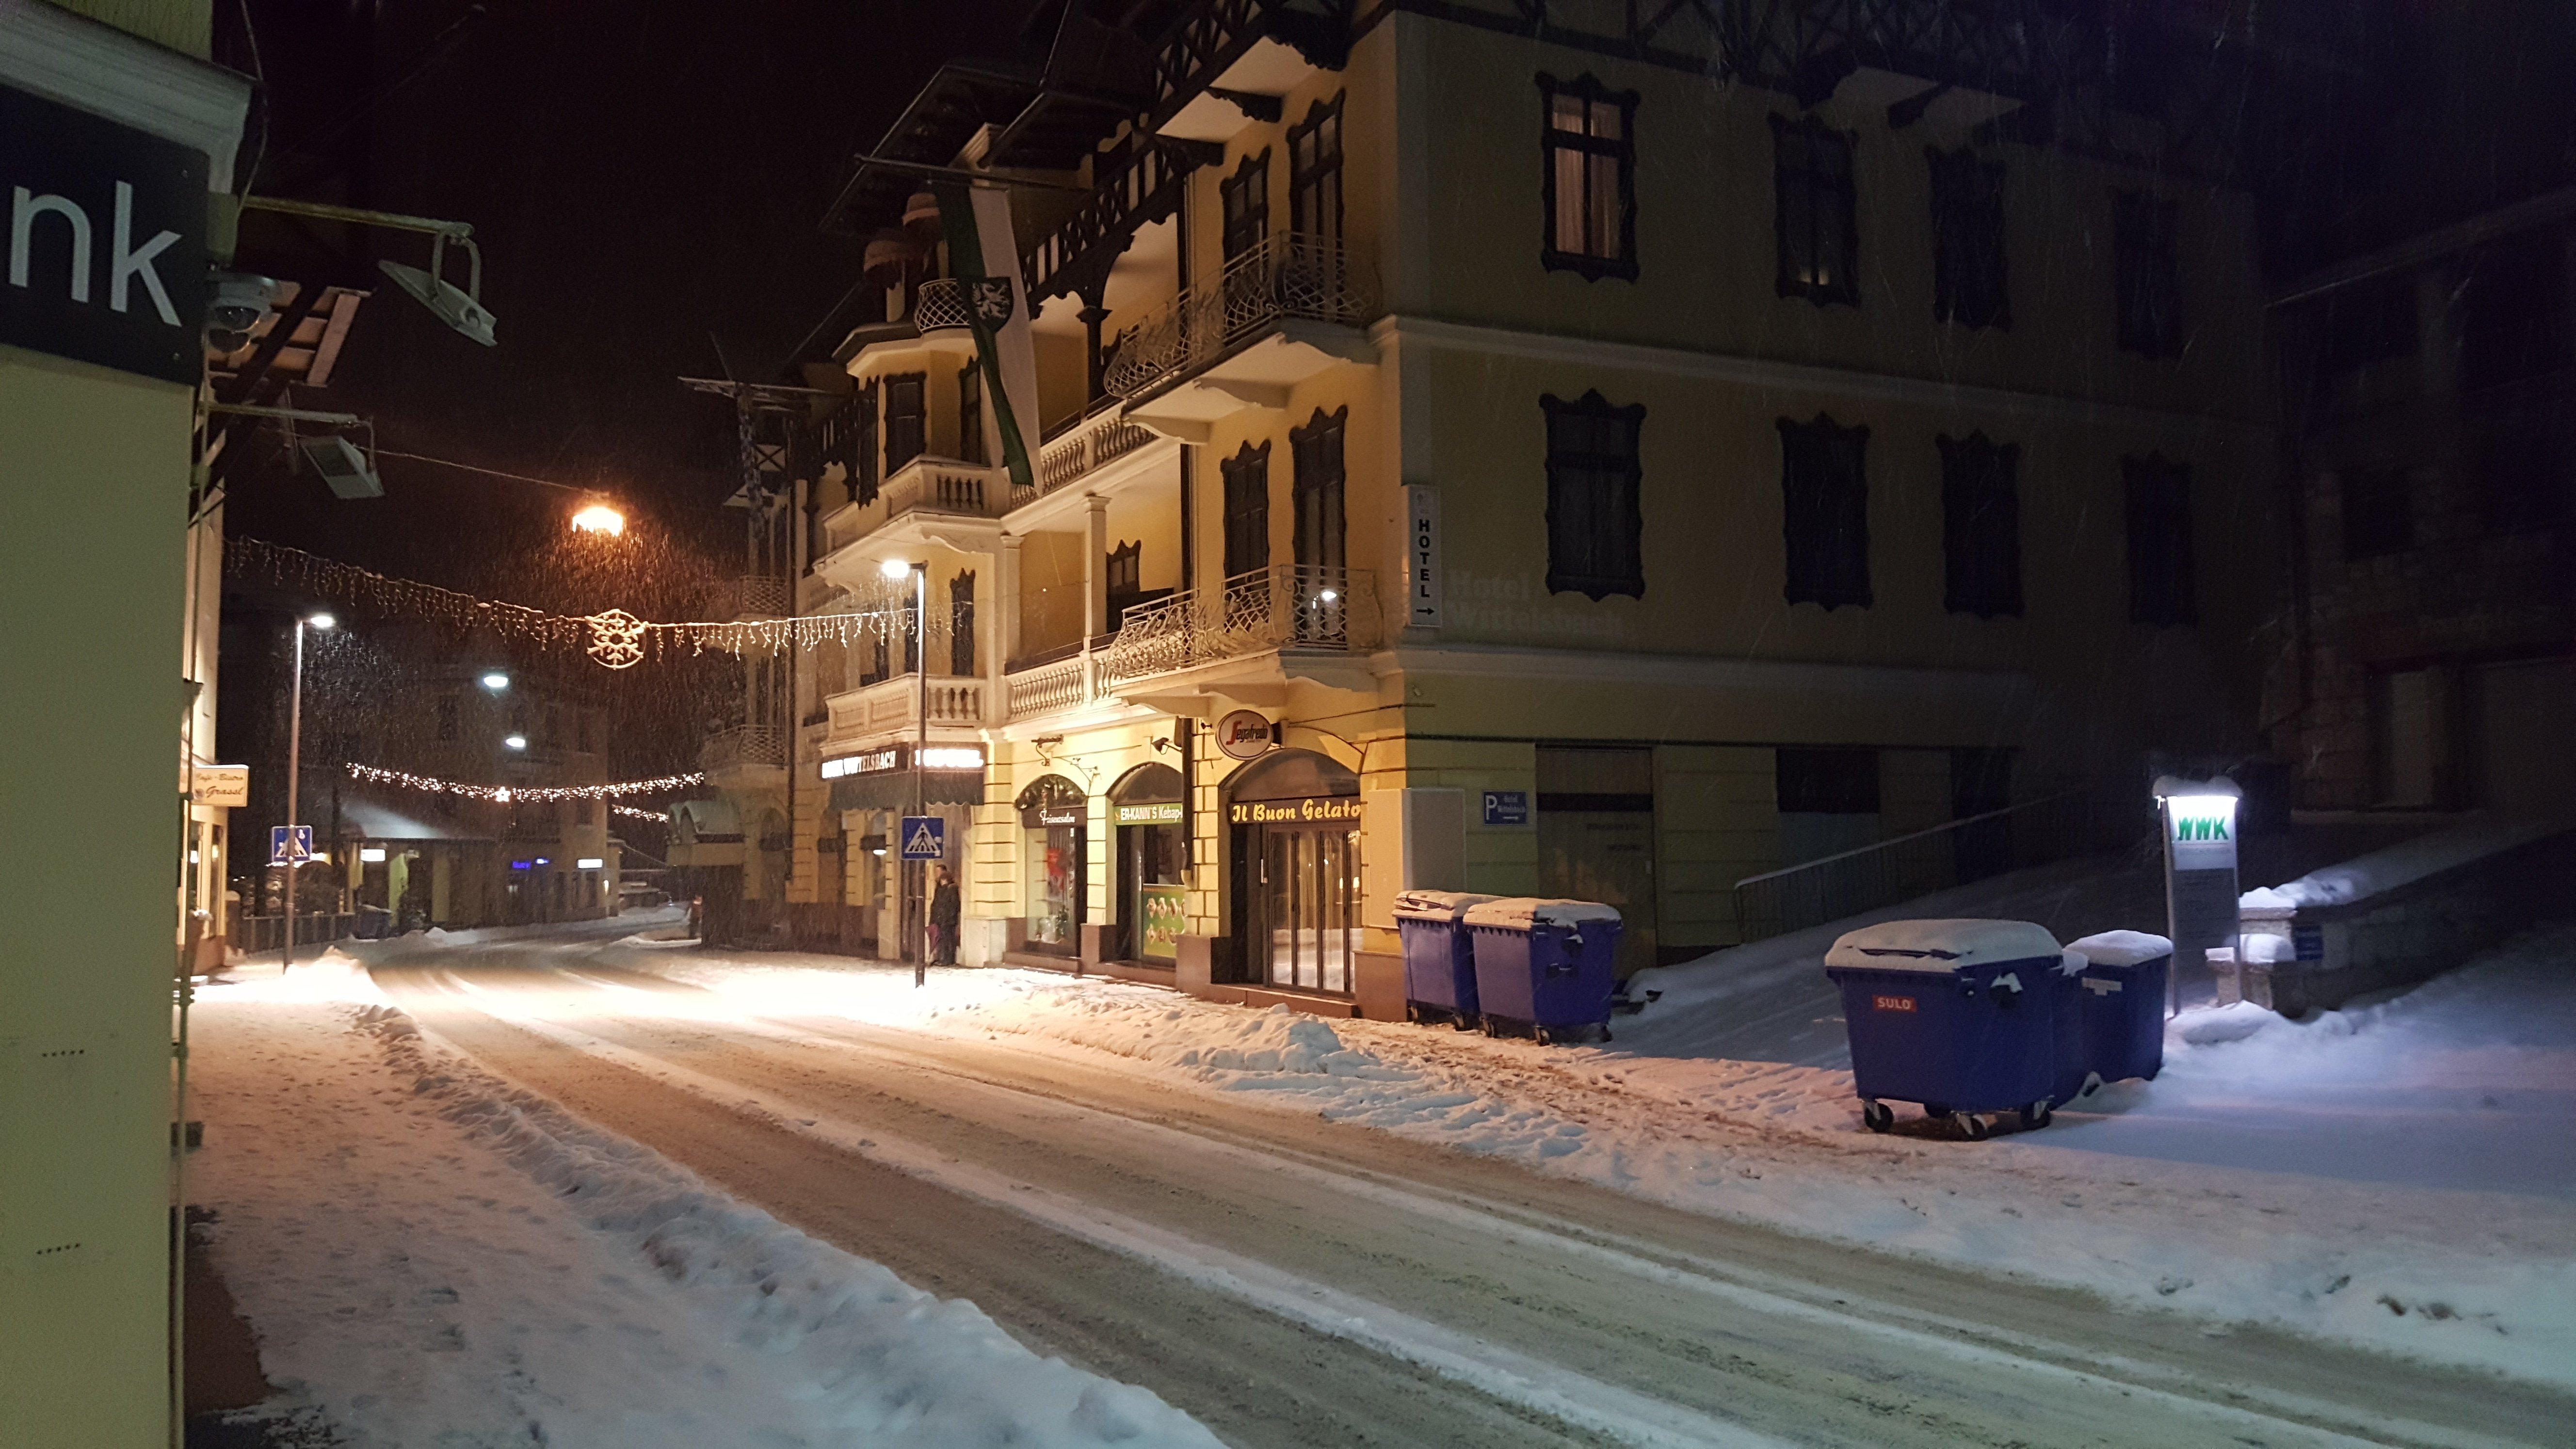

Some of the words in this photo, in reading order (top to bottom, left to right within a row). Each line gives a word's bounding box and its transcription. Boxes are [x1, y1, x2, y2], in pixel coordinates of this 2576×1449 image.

[9, 180, 182, 327] nk
[1418, 519, 1430, 598] HOTEL
[1448, 568, 1530, 602] Hotel
[1232, 805, 1248, 822] Il
[1253, 803, 1296, 821] Buon
[1302, 798, 1361, 821] Gelato
[1485, 795, 1497, 820] P
[2178, 816, 2229, 840] WWK
[1877, 997, 1911, 1010] SULO
